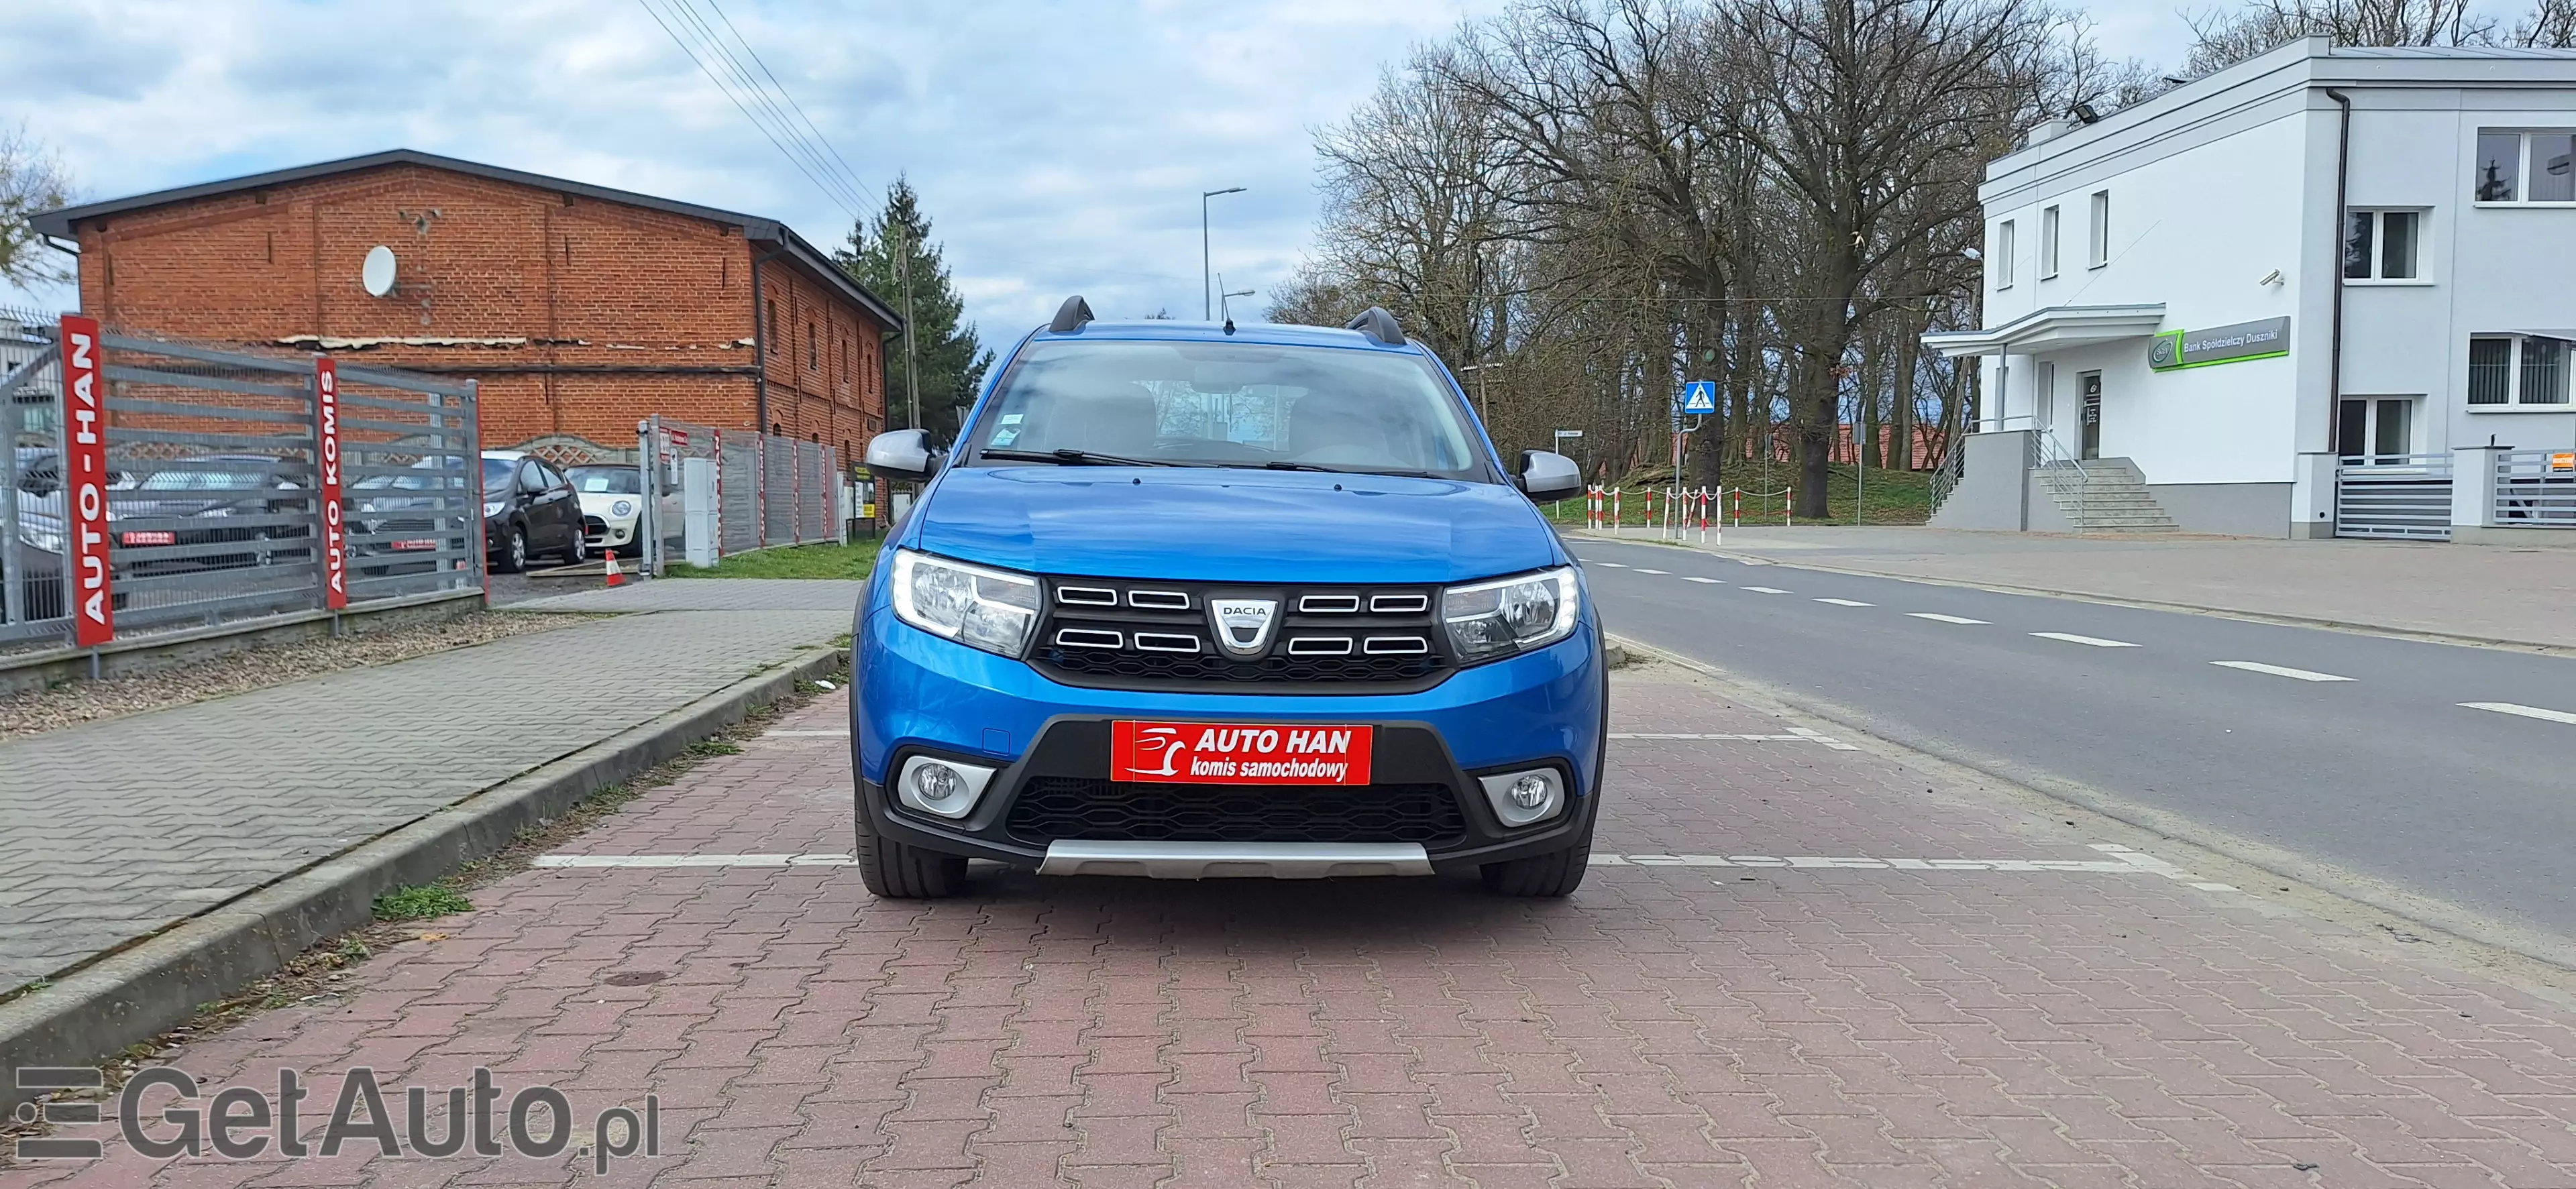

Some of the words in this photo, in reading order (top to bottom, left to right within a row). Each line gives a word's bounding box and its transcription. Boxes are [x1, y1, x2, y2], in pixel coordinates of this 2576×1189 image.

[2184, 341, 2201, 353] Bank
[2247, 329, 2278, 344] Duszniki
[321, 370, 338, 486] KOMIS
[327, 500, 343, 594] AUTO
[1224, 607, 1267, 616] DACIA
[1194, 728, 1279, 753] AUTO
[1285, 730, 1352, 754] HAN
[1190, 756, 1236, 777] komis
[1239, 758, 1349, 783] samochodowy
